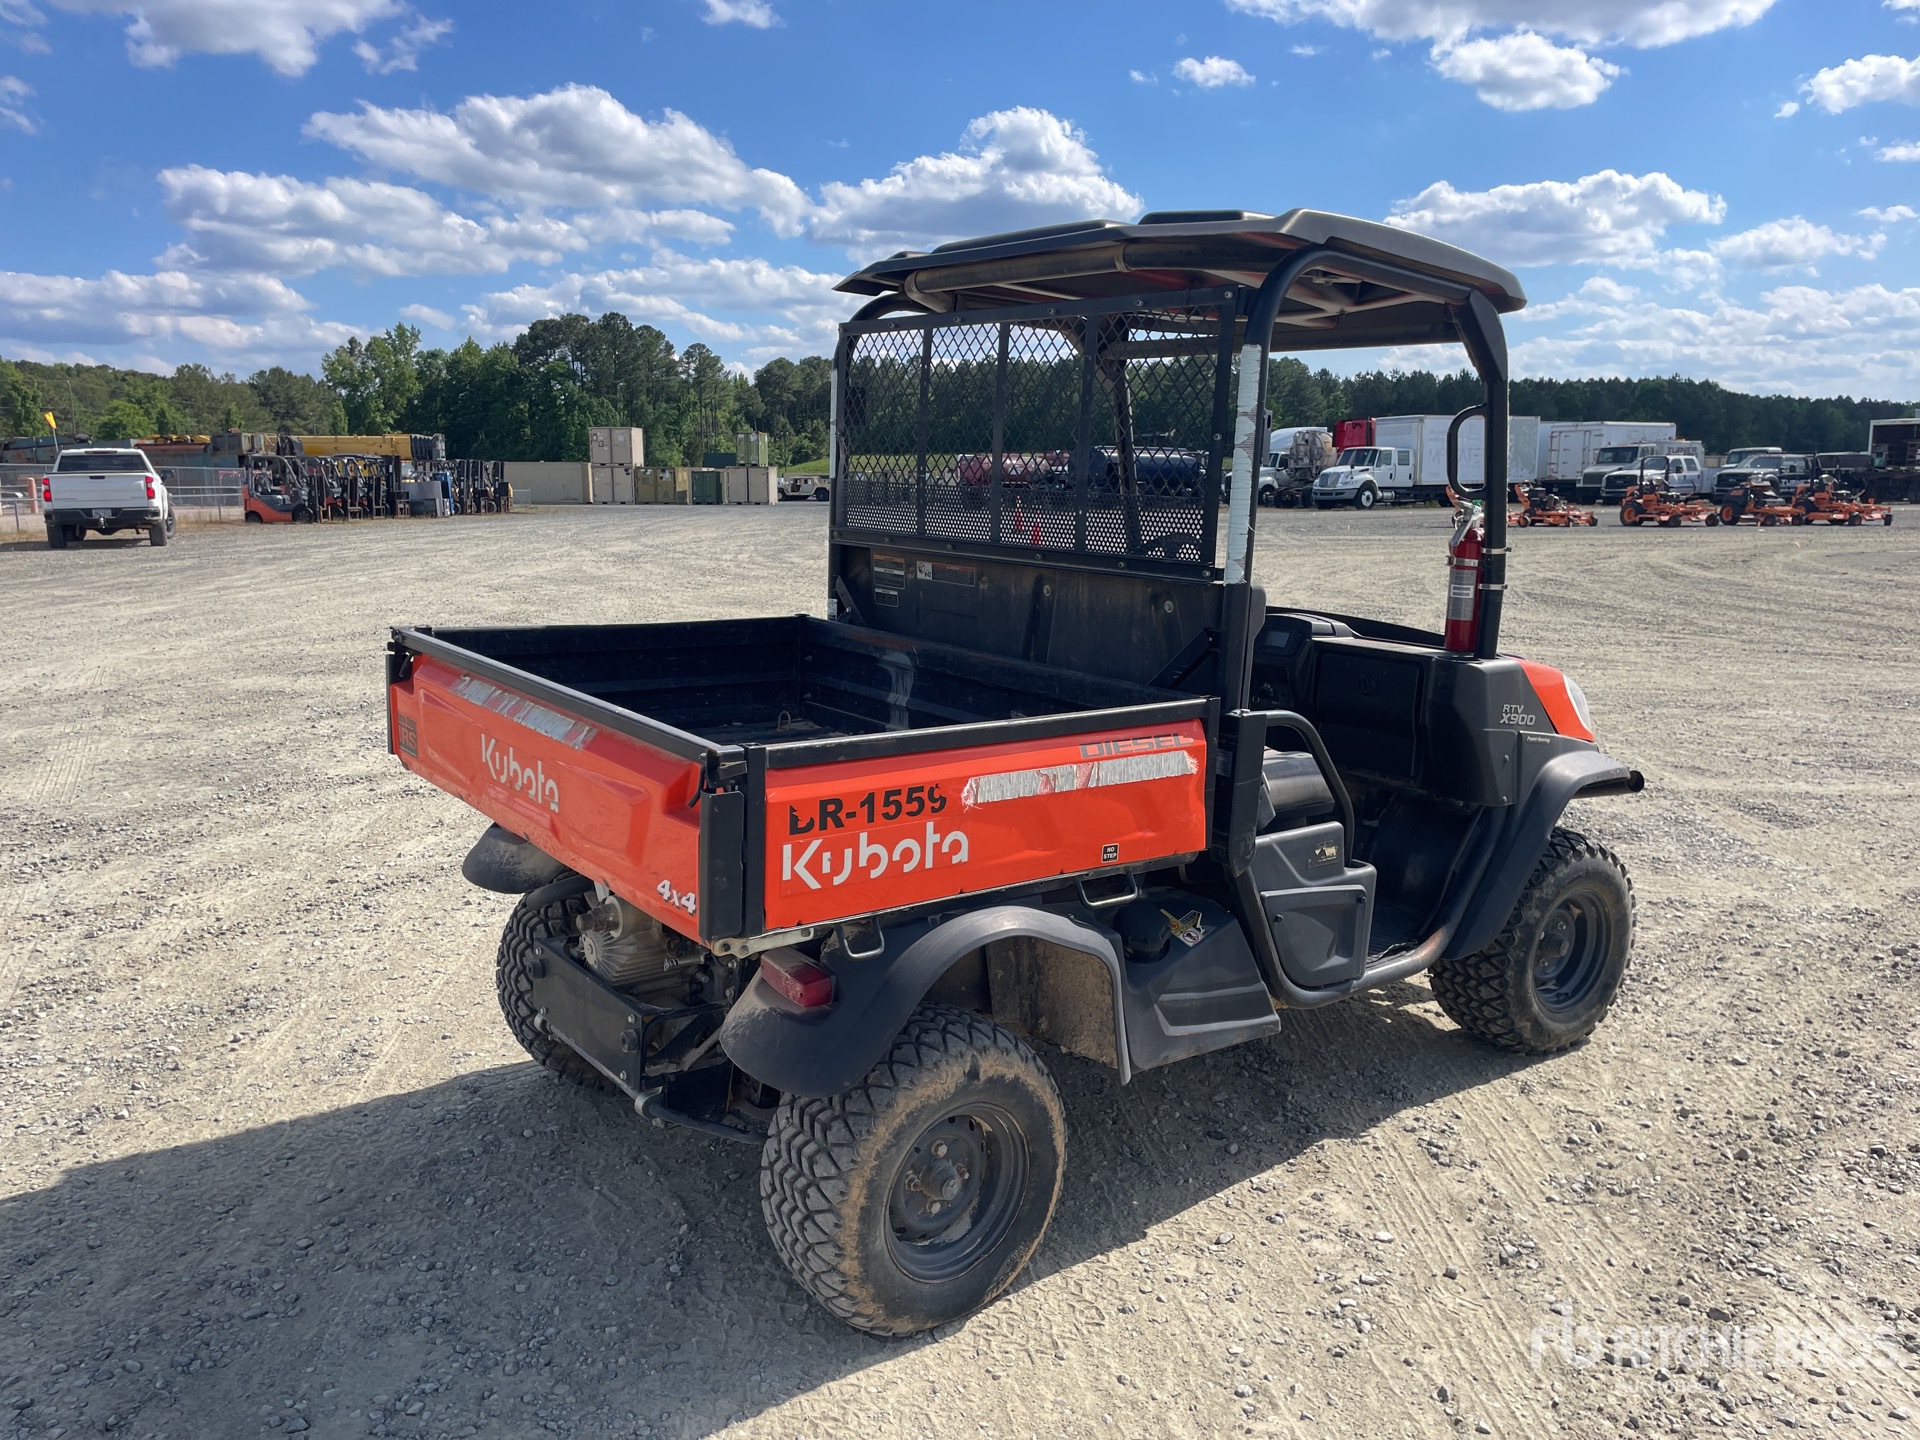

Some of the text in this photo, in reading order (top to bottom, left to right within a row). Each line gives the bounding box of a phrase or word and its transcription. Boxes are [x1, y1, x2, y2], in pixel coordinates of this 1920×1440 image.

[1500, 713, 1536, 726] X900
[1503, 704, 1524, 714] RTV
[1079, 733, 1194, 758] DIESEL
[481, 733, 559, 813] Kubota
[782, 821, 969, 889] Kubota
[1103, 852, 1117, 860] STEP
[656, 879, 697, 915] 4x4
